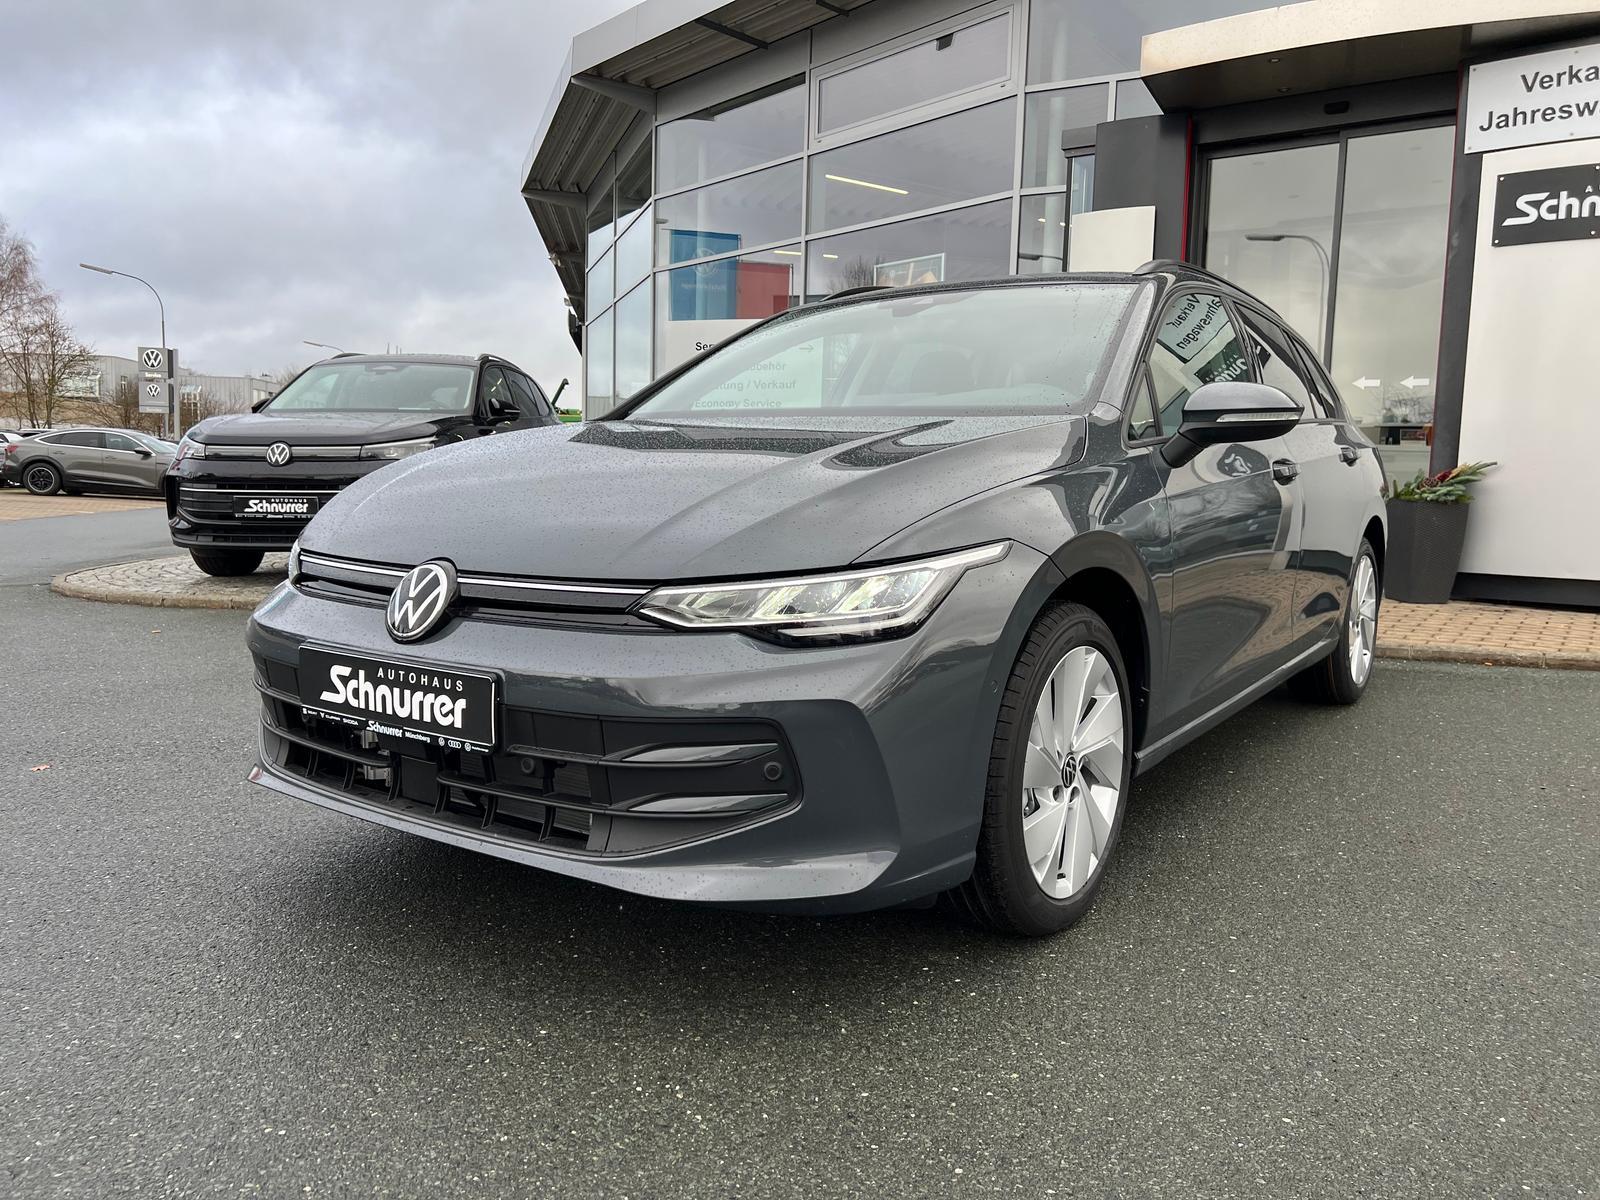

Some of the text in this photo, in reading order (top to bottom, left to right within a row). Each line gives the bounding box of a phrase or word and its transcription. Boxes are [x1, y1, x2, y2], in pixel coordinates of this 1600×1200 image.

[1521, 65, 1600, 93] Verka
[1479, 100, 1600, 132] Jahresw
[754, 379, 797, 390] Verkauf
[743, 398, 783, 408] Service
[244, 499, 309, 513] Schnurrer
[377, 667, 464, 692] AUTOHAUS
[319, 664, 467, 729] Schnurrer
[366, 720, 403, 738] Schnurrer
